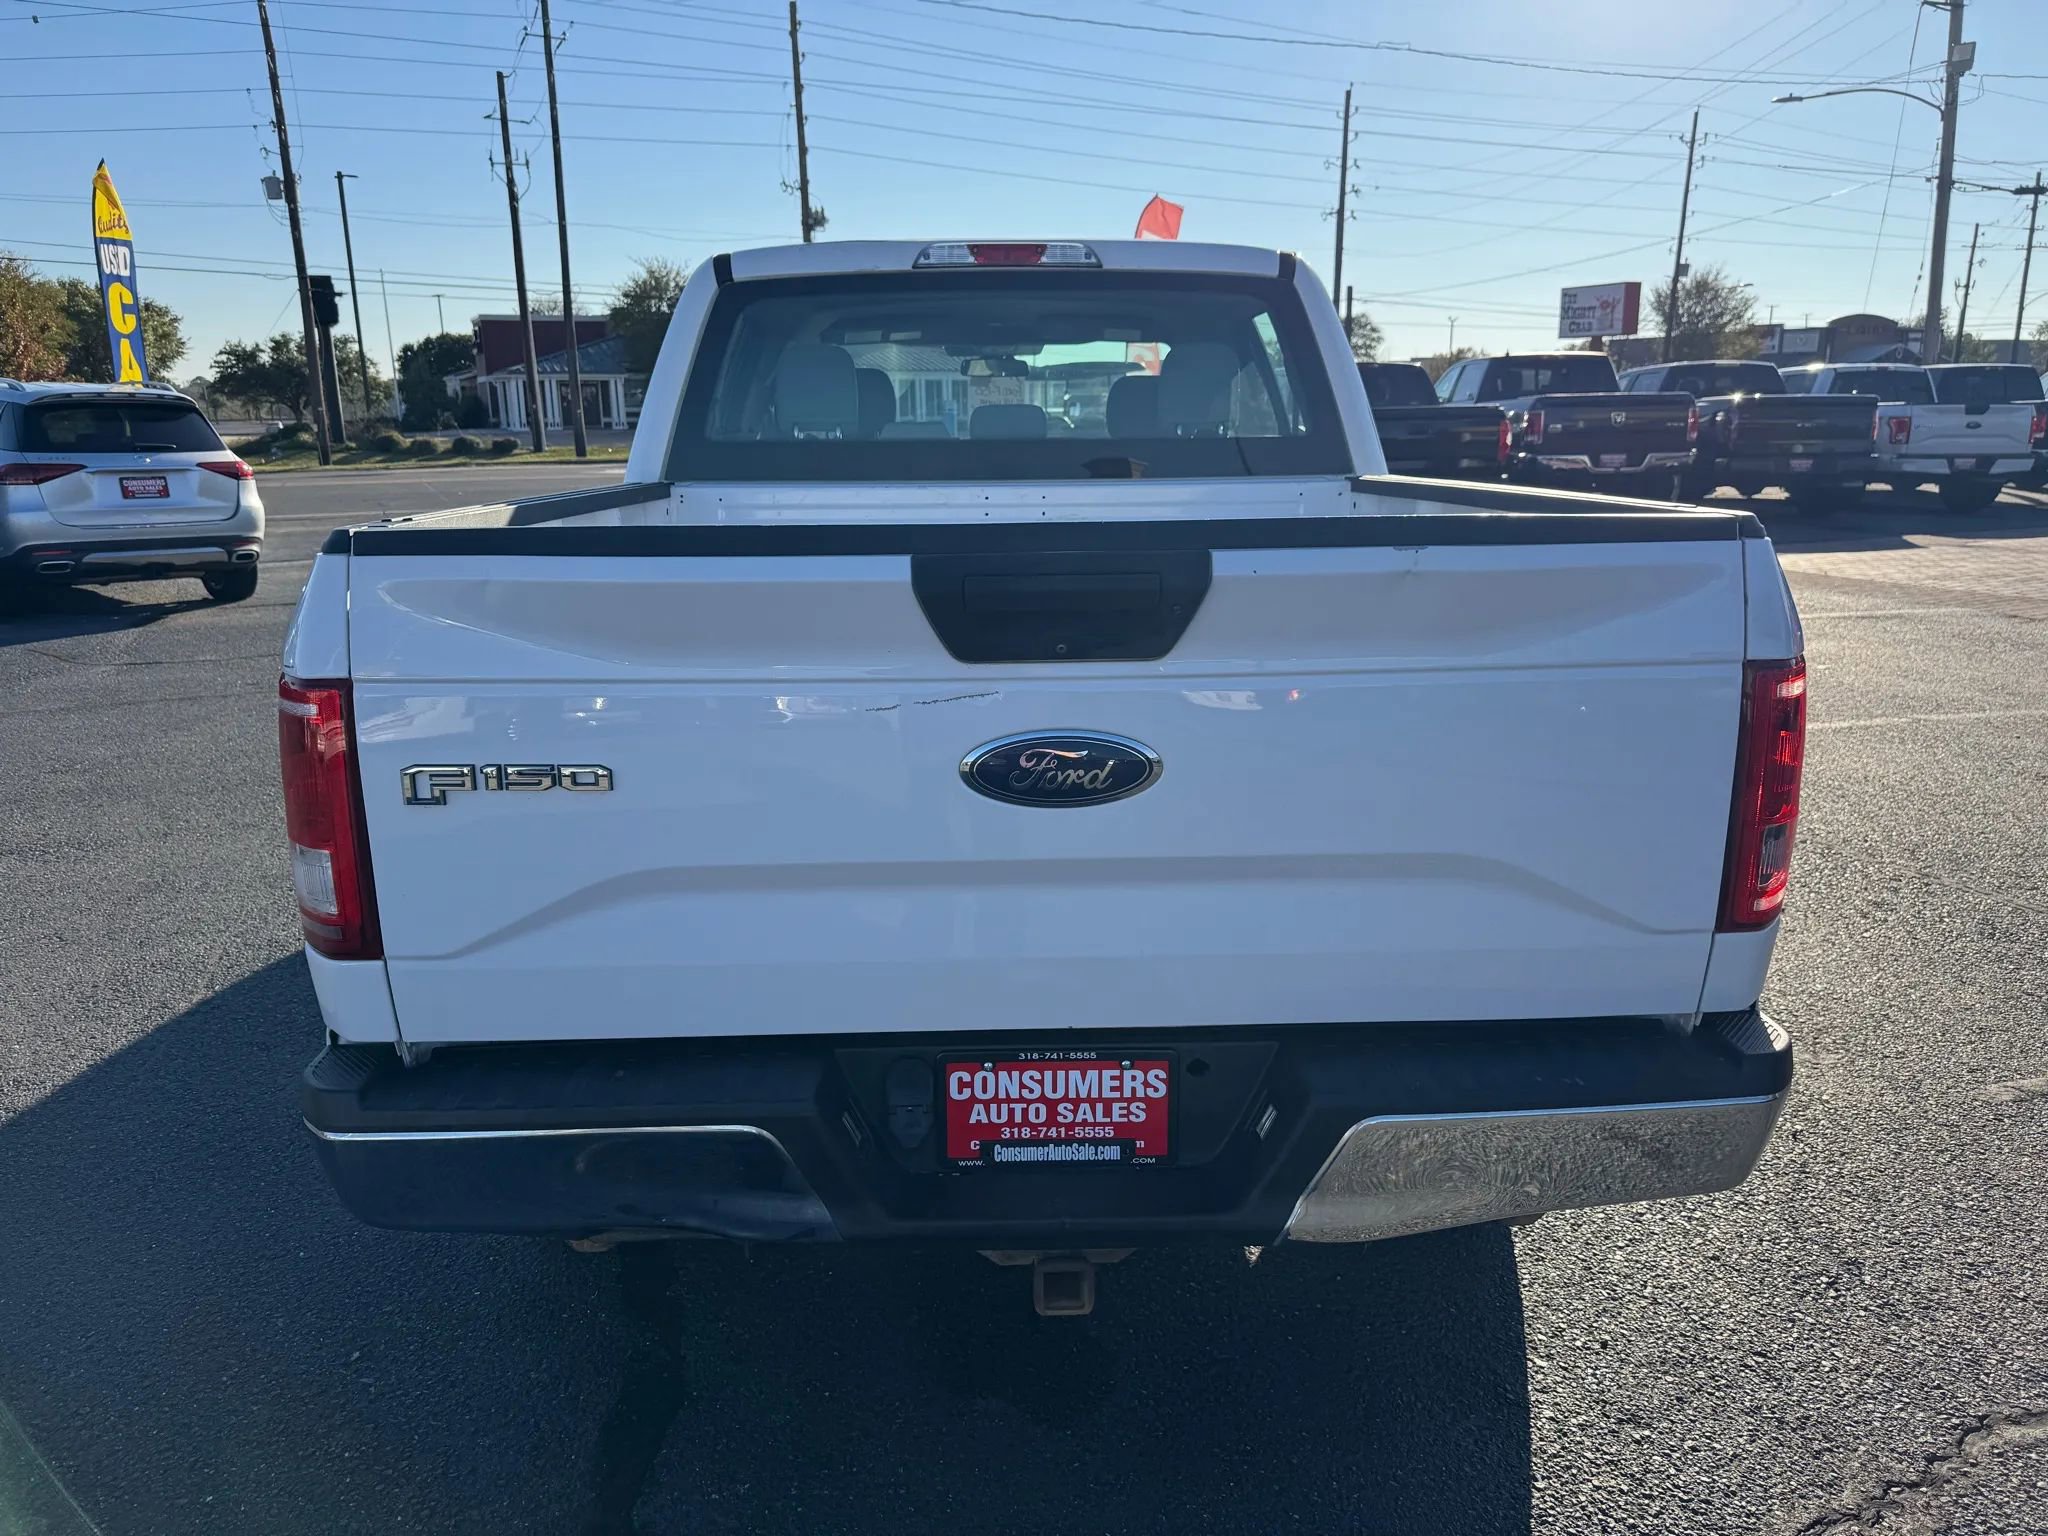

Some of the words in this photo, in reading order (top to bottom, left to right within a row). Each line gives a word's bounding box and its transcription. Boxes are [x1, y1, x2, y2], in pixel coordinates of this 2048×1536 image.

[1009, 748, 1113, 790] Ford
[1018, 1052, 1097, 1060] 318-741-5555
[949, 1069, 1167, 1100] CONSUMERS
[968, 1103, 1047, 1123] AUTO
[1057, 1102, 1146, 1123] SALES
[1000, 1126, 1115, 1139] 318-741-5555
[993, 1143, 1121, 1162] ConsumerAutoSale.com
